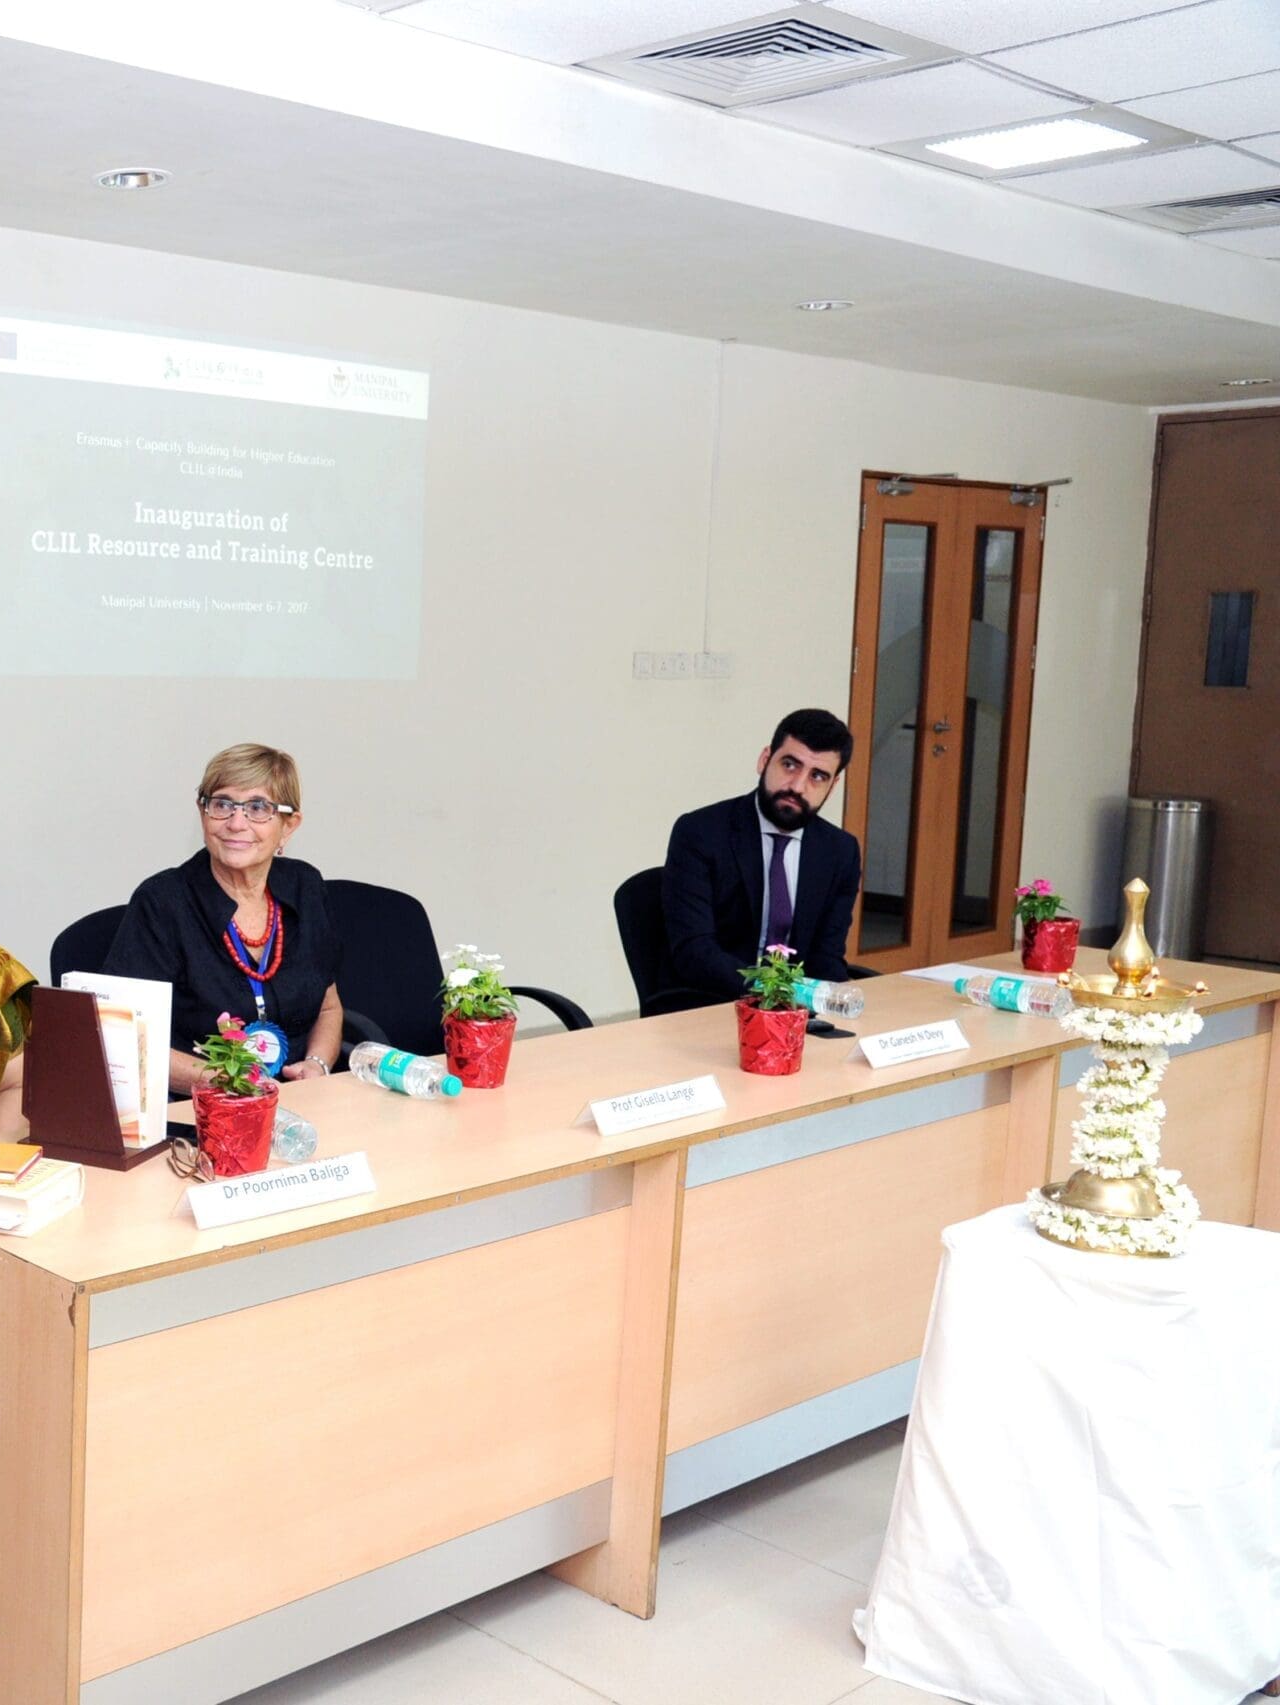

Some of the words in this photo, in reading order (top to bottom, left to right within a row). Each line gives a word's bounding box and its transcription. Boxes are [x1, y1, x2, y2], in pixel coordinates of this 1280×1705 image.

[352, 371, 399, 388] MANIPAL
[352, 385, 412, 403] UNIVERSITY
[136, 437, 182, 456] Capacity
[187, 441, 230, 460] Building
[233, 447, 248, 459] for
[251, 448, 284, 465] Higher
[288, 452, 336, 468] Education
[135, 502, 265, 530] Inauguration
[270, 512, 289, 532] of
[31, 530, 81, 553] CLIL
[87, 533, 180, 559] Resource
[186, 540, 222, 561] and
[228, 541, 309, 570] Training
[314, 547, 373, 569] Centre
[101, 594, 146, 611] Manipal
[148, 596, 201, 612] University
[211, 599, 263, 613] November
[890, 1033, 917, 1047] Ganesh
[611, 1099, 633, 1112] Prof
[634, 1092, 666, 1108] Gisella
[223, 1185, 242, 1199] Dr
[243, 1173, 308, 1195] Poornima
[309, 1164, 350, 1182] Baliga
